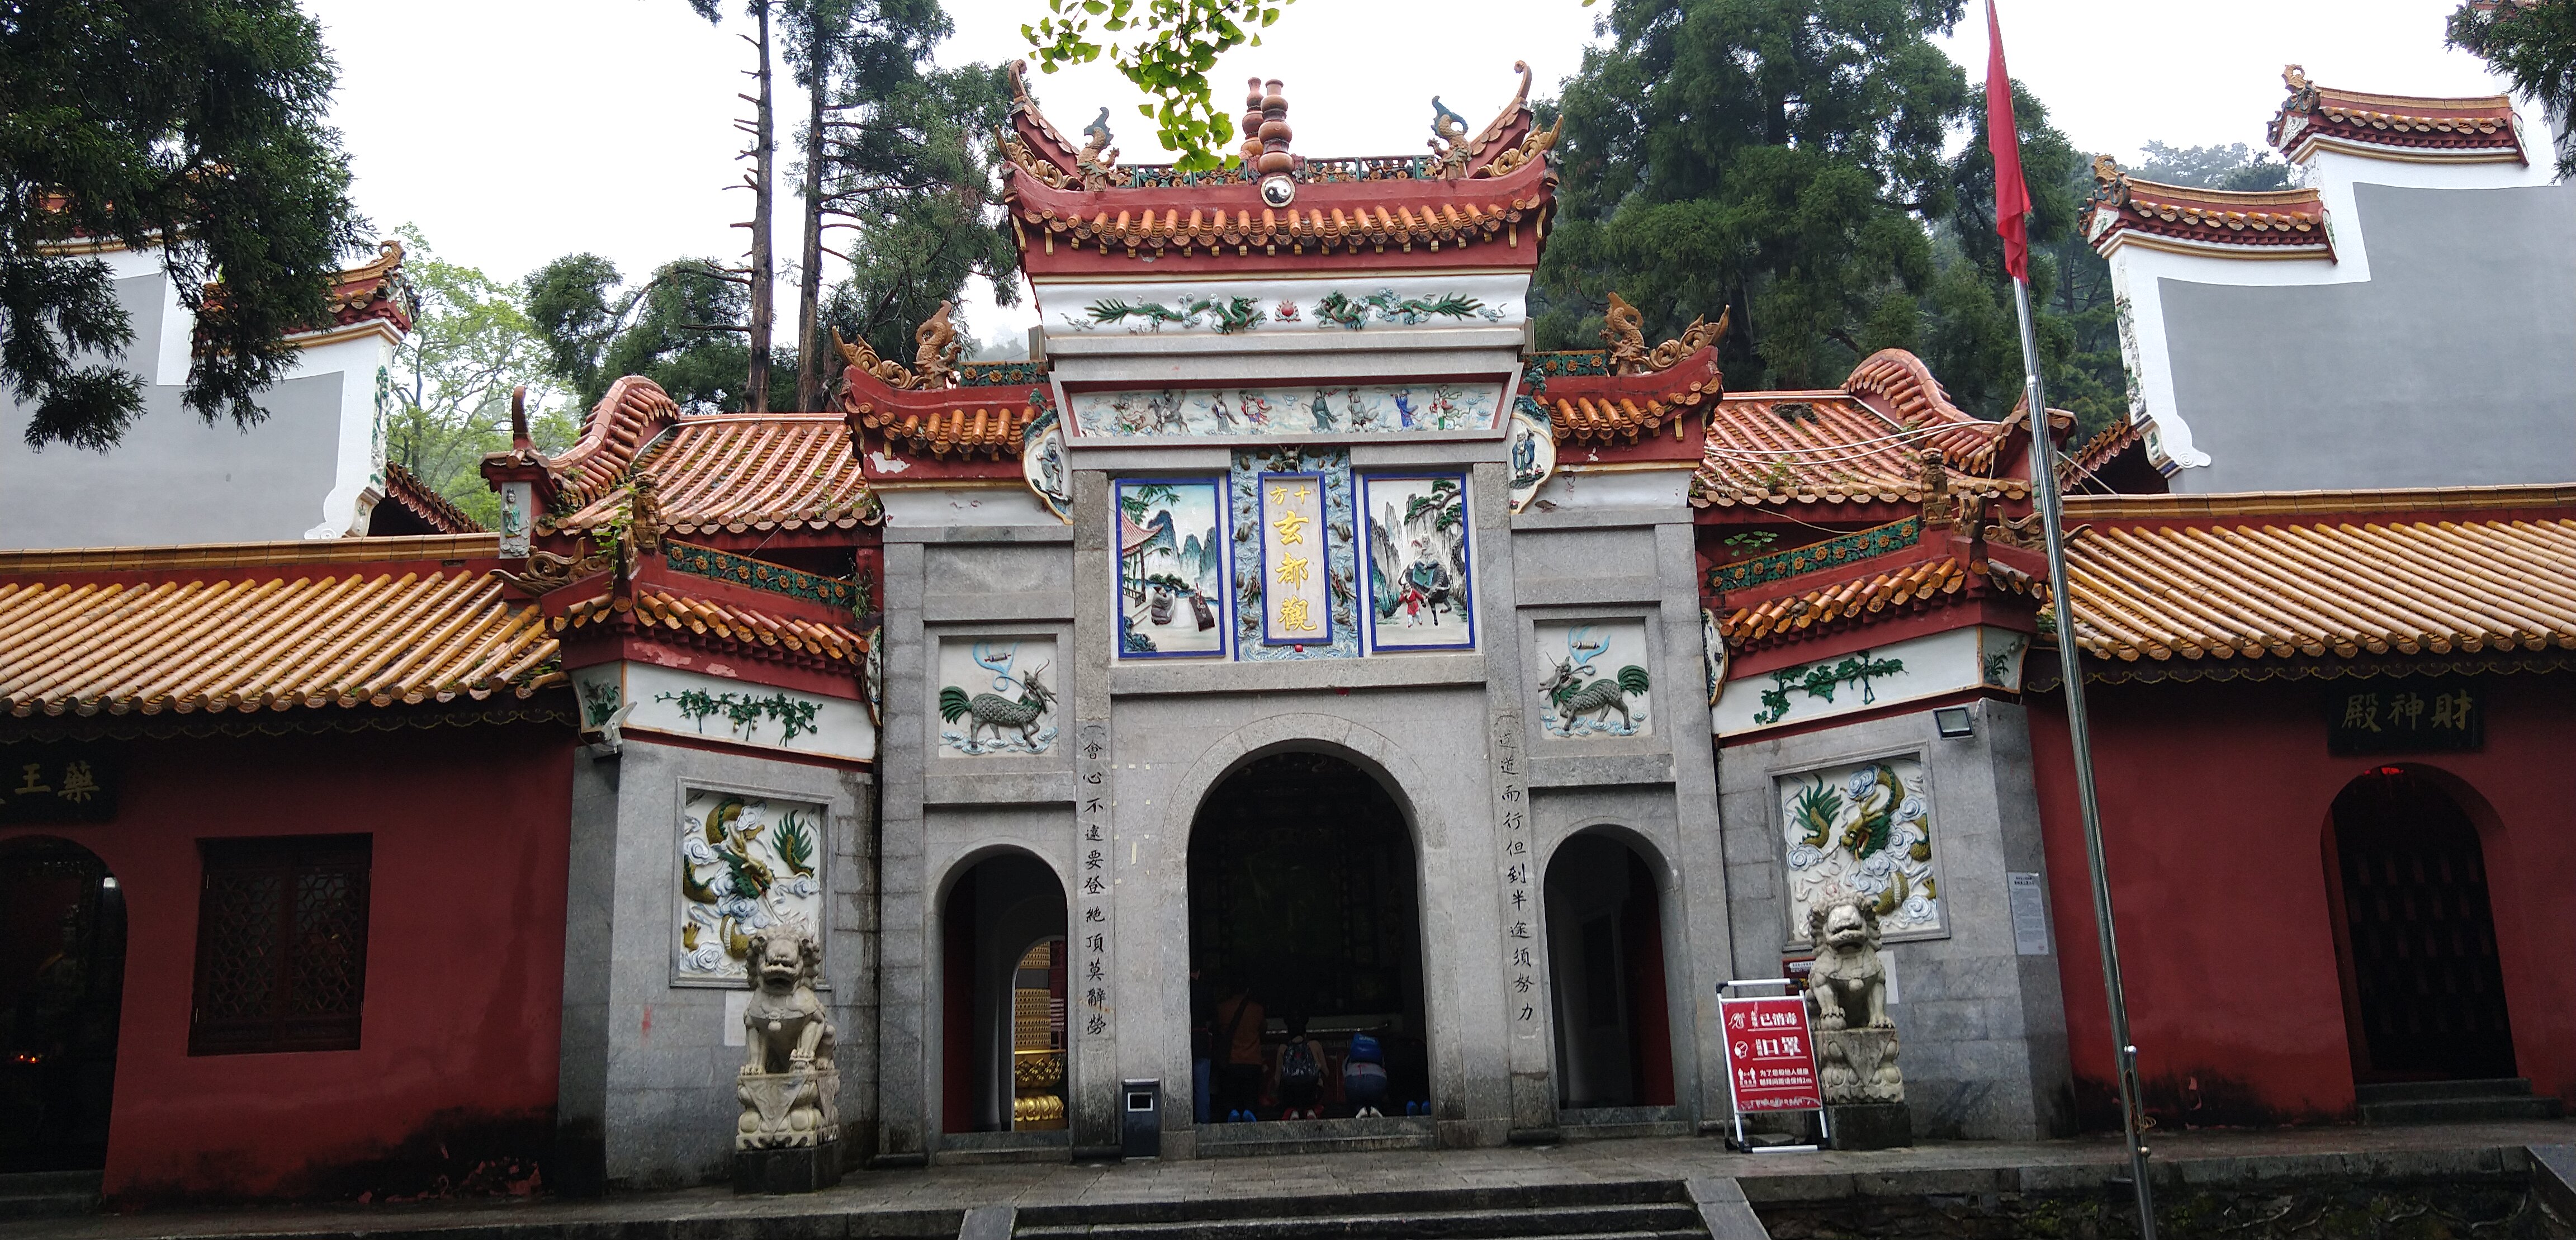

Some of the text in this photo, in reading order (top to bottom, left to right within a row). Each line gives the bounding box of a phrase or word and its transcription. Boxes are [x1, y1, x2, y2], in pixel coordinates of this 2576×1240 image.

[1270, 485, 1311, 504] 十方
[2342, 689, 2473, 732] 財神殿
[0, 760, 100, 804] 藥王
[1761, 1036, 1801, 1056] 口罩
